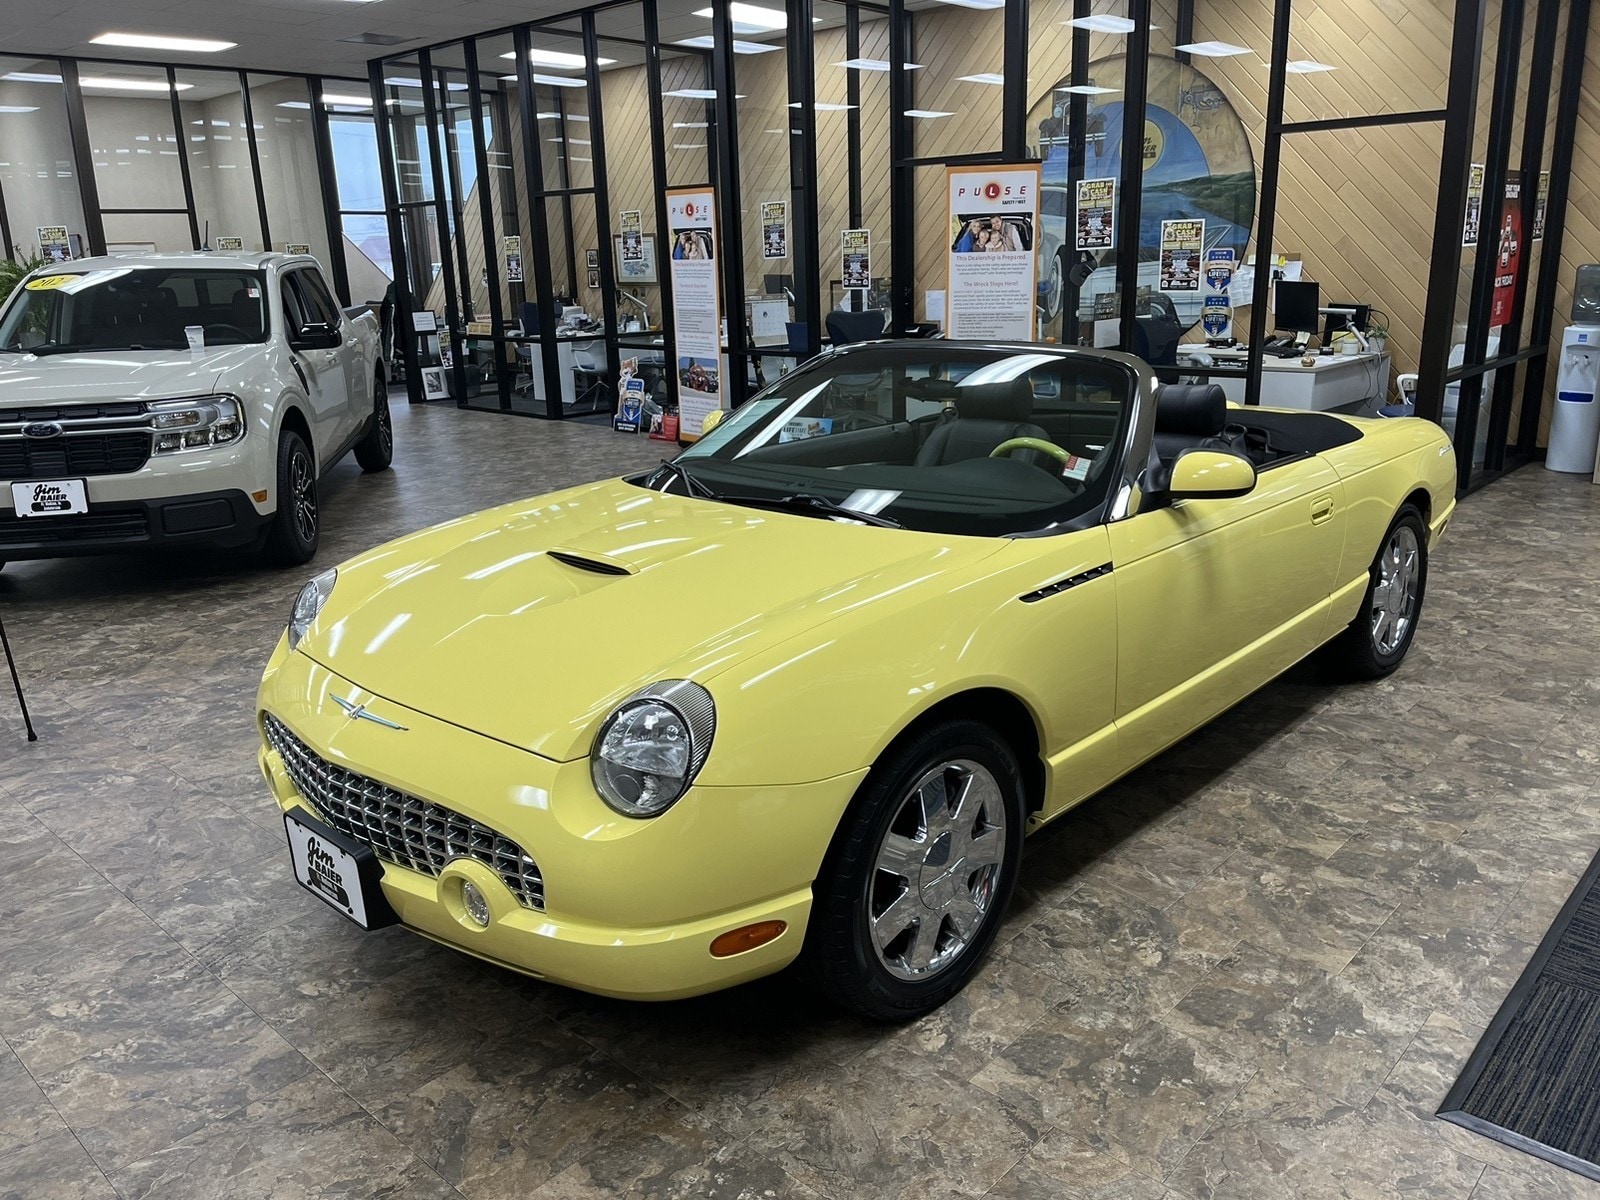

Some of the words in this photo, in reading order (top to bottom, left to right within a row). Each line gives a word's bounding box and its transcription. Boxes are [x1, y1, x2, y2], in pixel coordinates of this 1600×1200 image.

[959, 186, 1027, 197] PULSE
[672, 205, 708, 215] PULSE
[967, 254, 996, 262] Dealership
[989, 280, 1004, 288] Stops
[33, 484, 61, 502] Jim
[308, 837, 335, 869] Jim
[314, 860, 343, 886] BAIER
